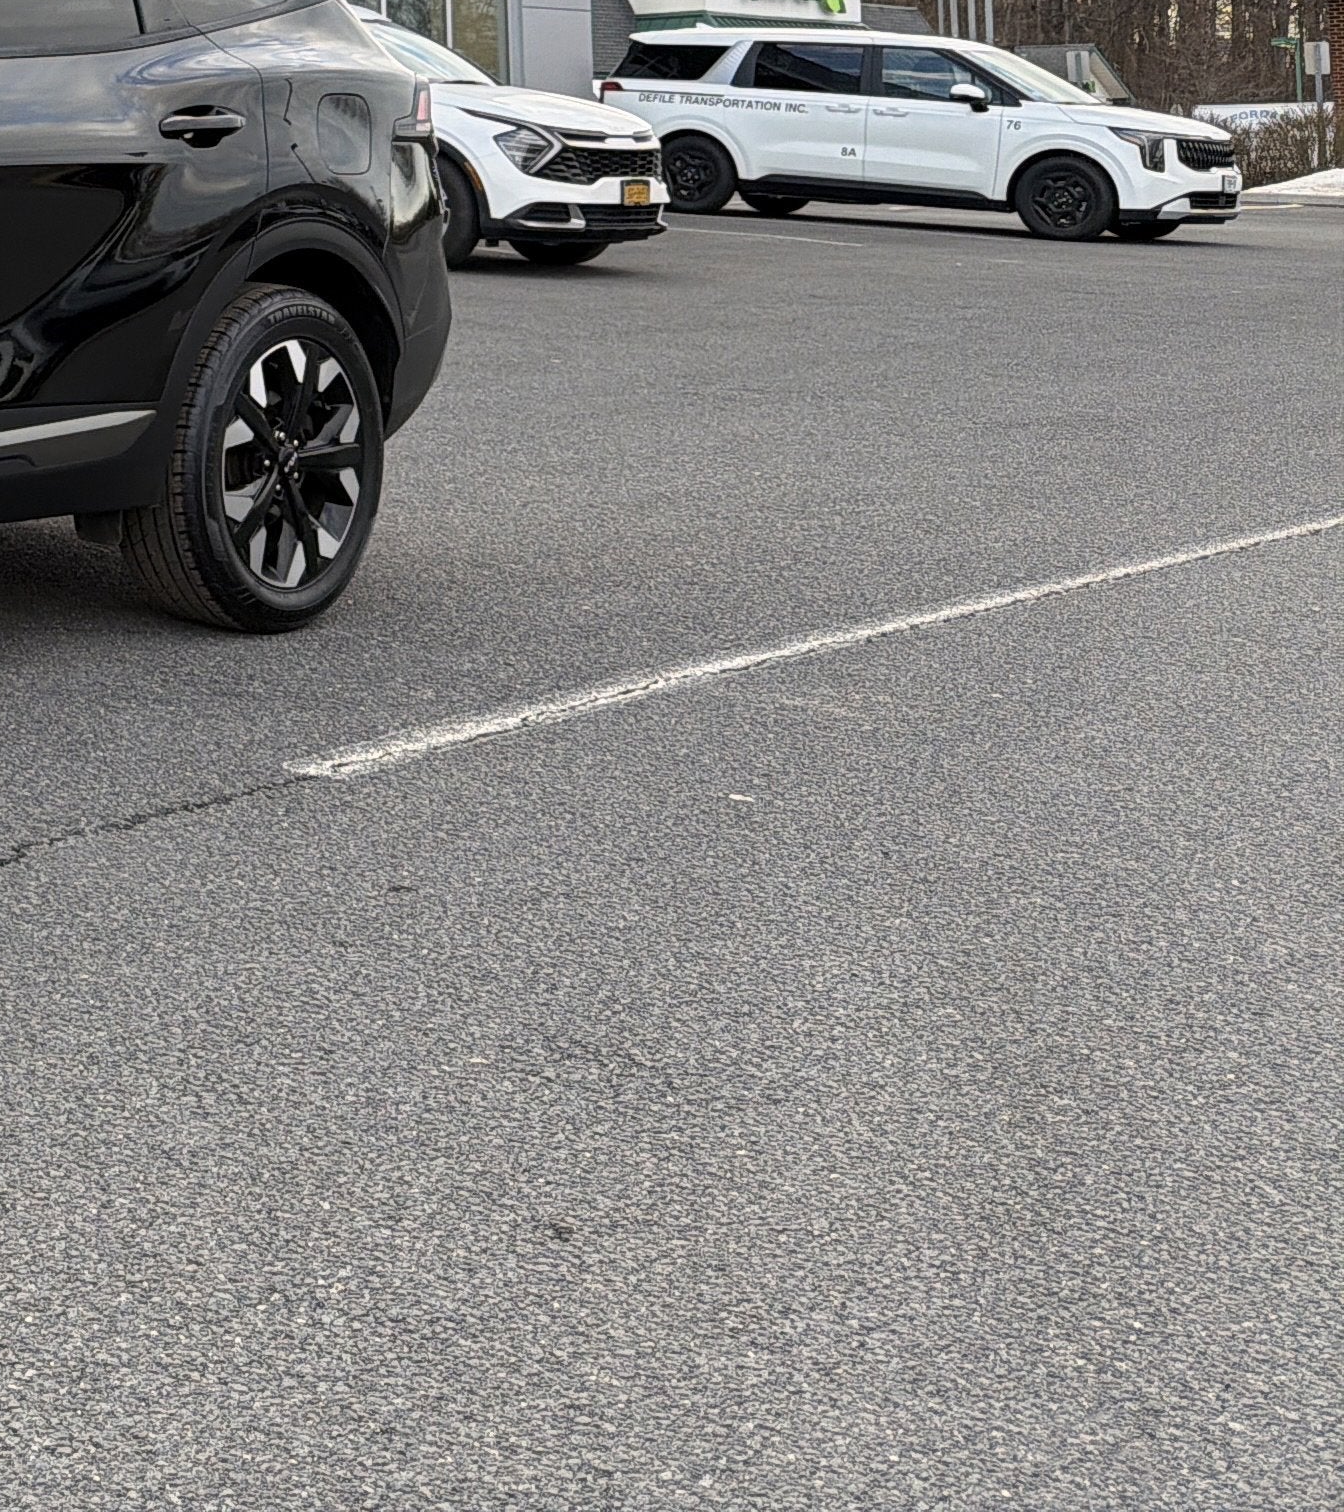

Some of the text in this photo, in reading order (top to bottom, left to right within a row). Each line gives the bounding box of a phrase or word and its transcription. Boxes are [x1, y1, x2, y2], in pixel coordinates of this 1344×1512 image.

[638, 92, 809, 114] DEFILE TRANSPORTATION INC.
[1006, 119, 1022, 131] 76
[840, 146, 857, 157] 8A
[268, 305, 335, 324] TRAVELSTAR
